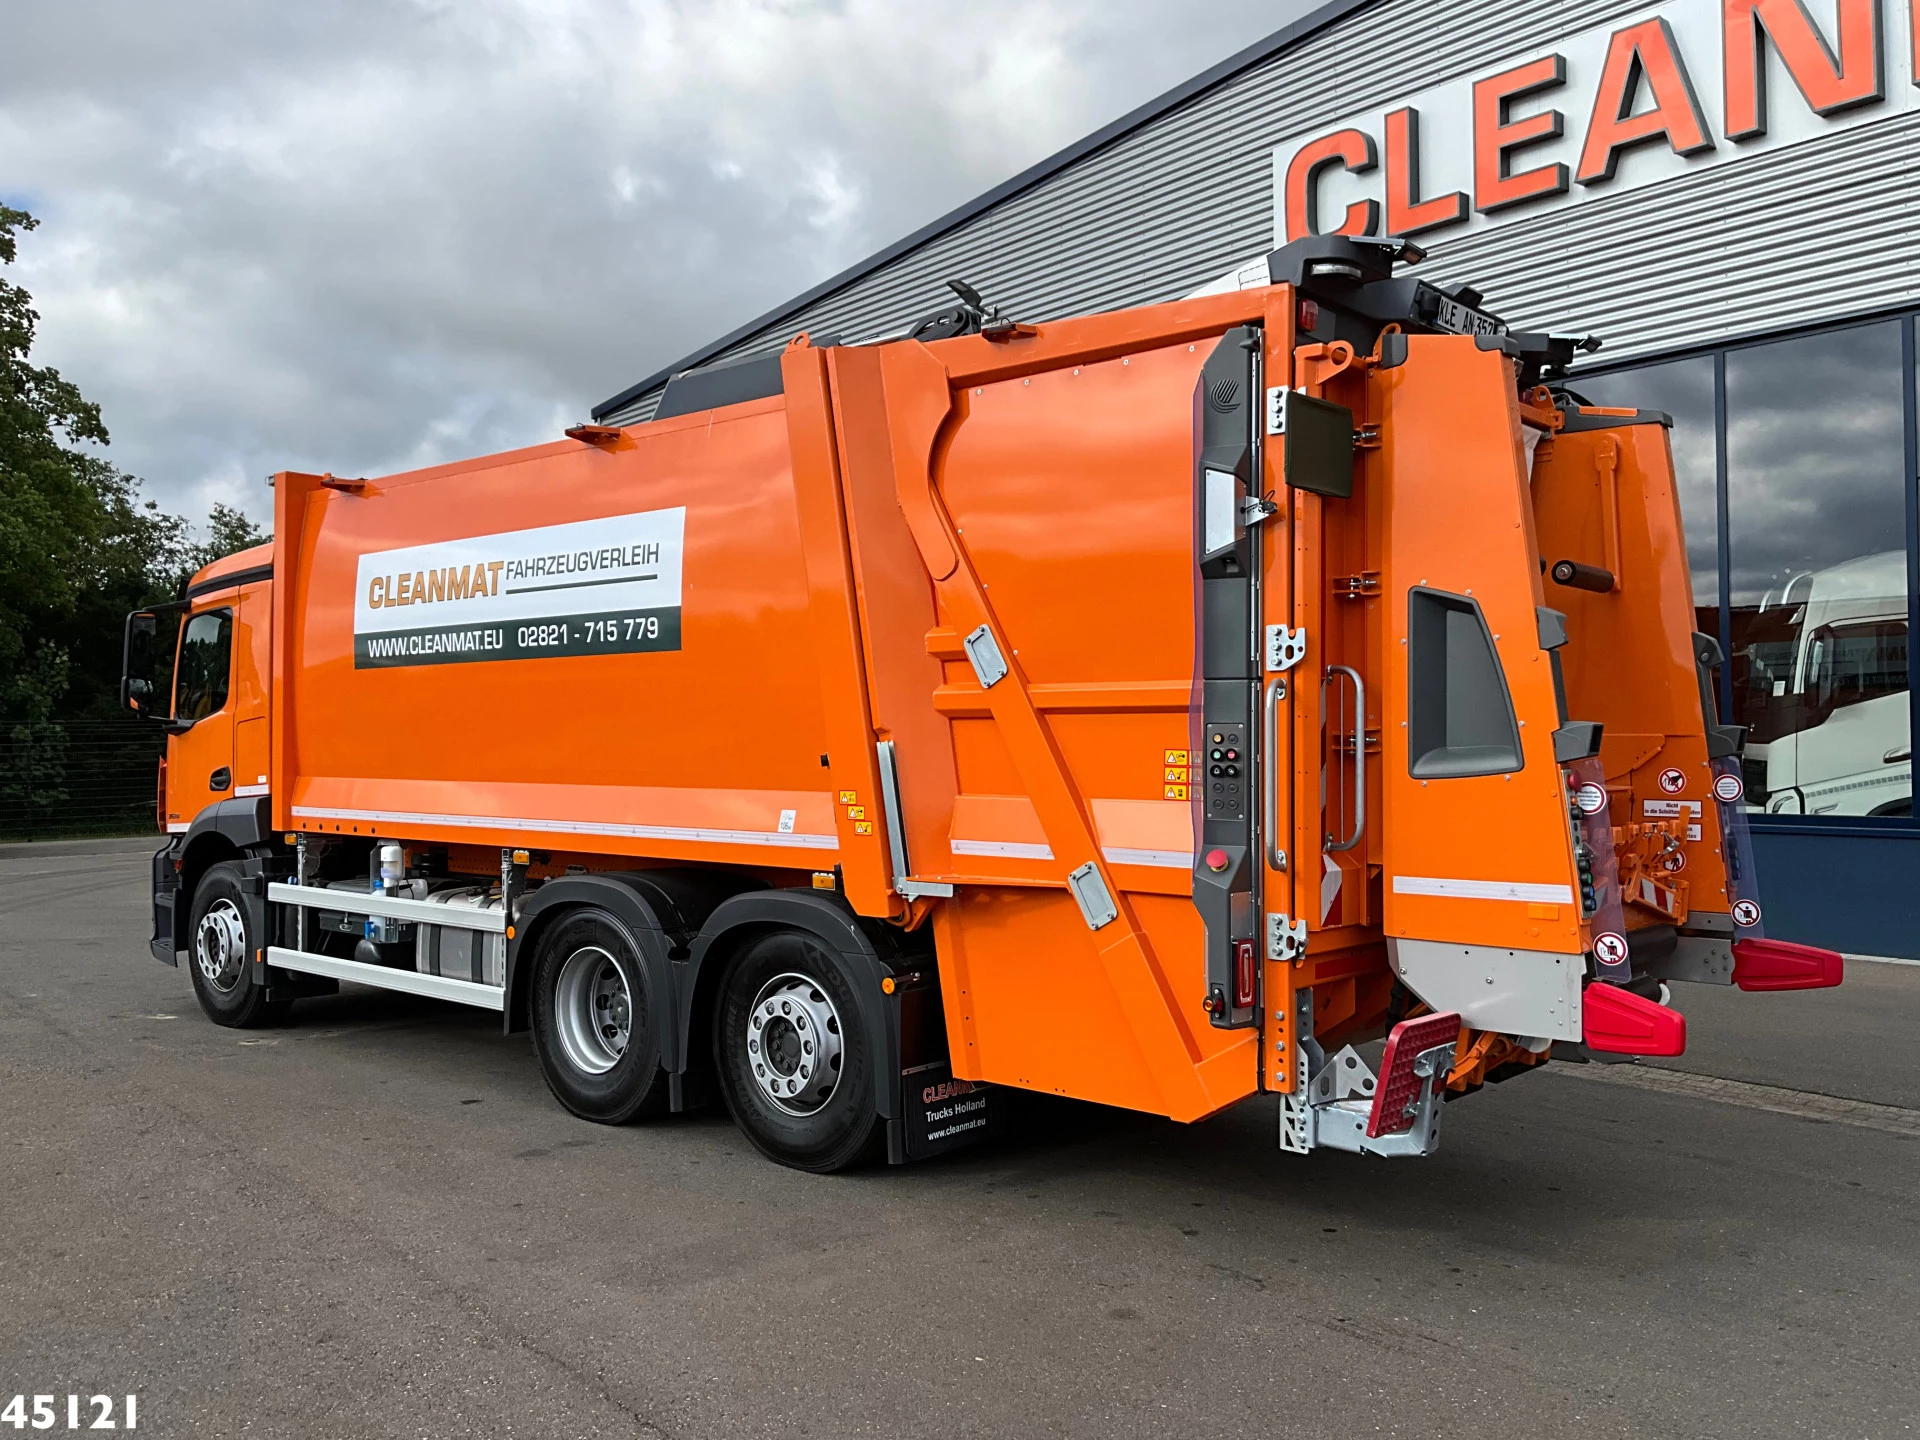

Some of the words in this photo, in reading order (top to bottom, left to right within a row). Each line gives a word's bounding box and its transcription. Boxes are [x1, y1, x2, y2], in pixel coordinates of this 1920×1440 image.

[1285, 0, 1920, 238] CLEAN
[1439, 299, 1457, 327] KLE
[1462, 311, 1475, 335] AN
[368, 560, 504, 609] CLEANMAT
[506, 543, 659, 580] FAHRZEUGVERLEIH
[368, 629, 503, 658] WWW.CLEANMAT.EU
[518, 624, 568, 647] 02821
[585, 620, 617, 642] 715
[624, 617, 658, 640] 779
[926, 1107, 953, 1122] Trucks
[955, 1097, 986, 1115] Holland
[928, 1118, 986, 1141] www.cleanmat.eu
